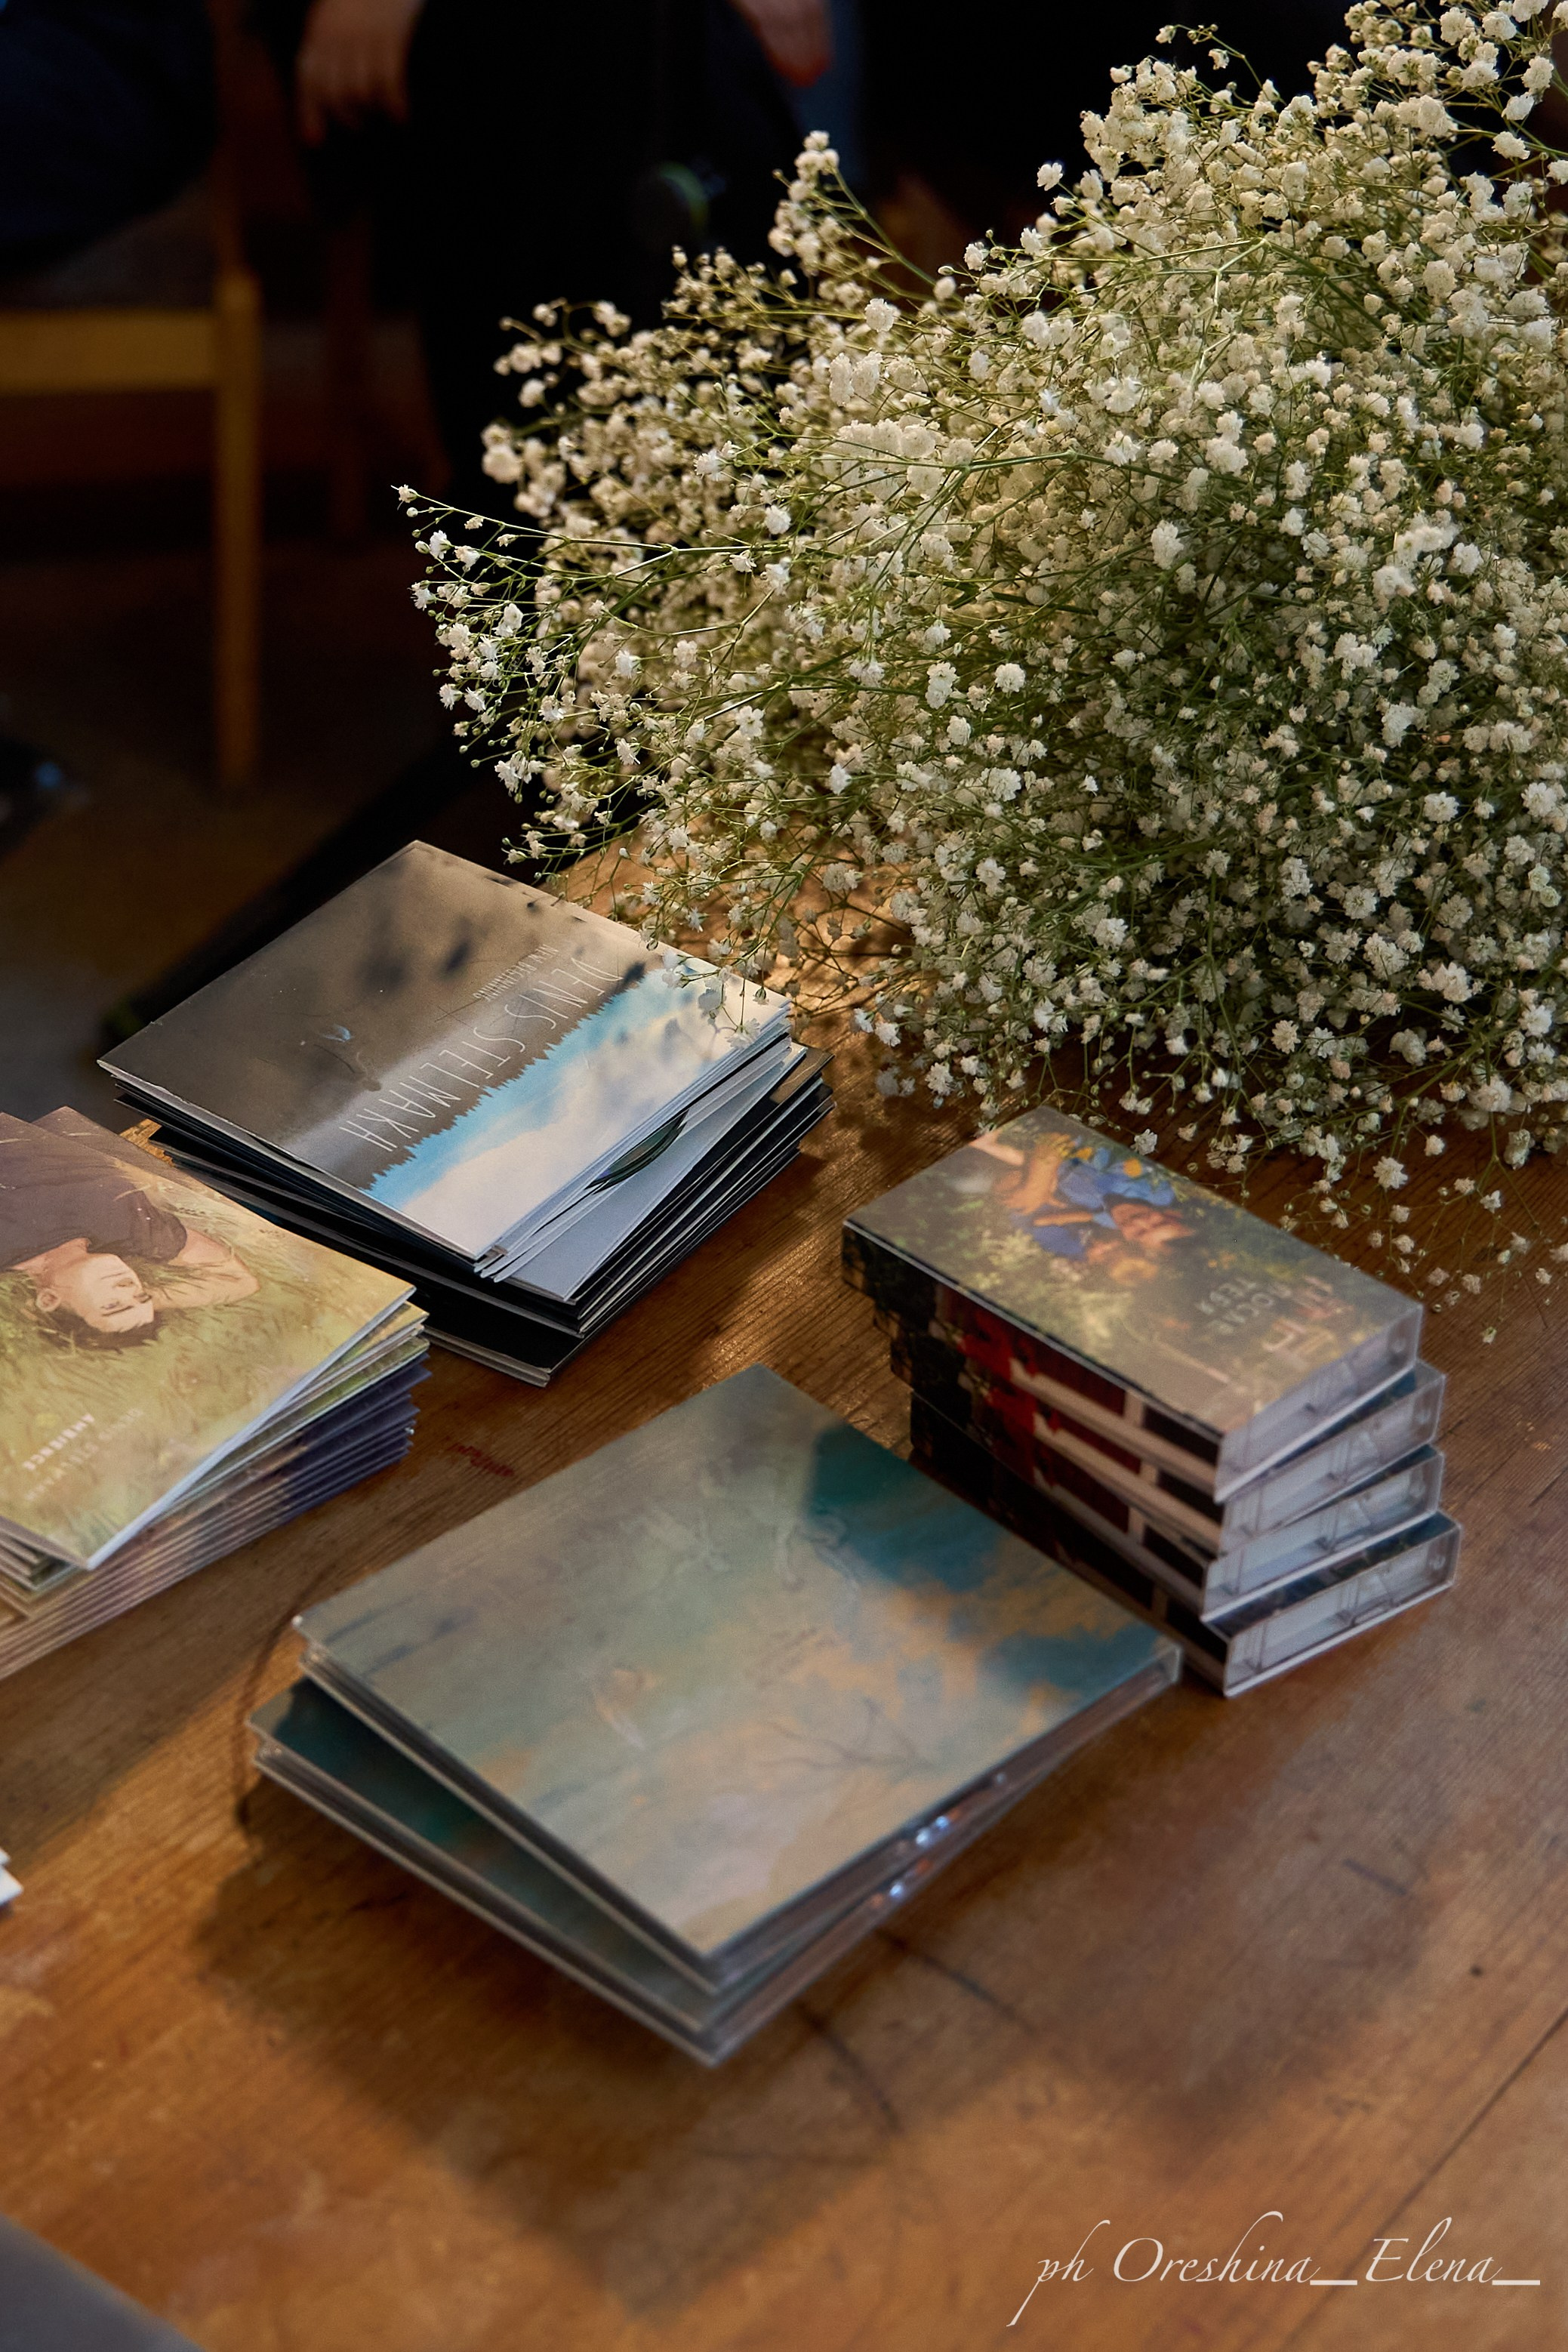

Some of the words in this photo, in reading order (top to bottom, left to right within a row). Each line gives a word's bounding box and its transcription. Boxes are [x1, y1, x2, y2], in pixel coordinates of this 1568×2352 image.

[473, 960, 538, 1002] BEGINNING
[528, 944, 559, 964] NEW
[504, 957, 624, 1030] DENIS
[338, 1027, 526, 1152] STELMAKH
